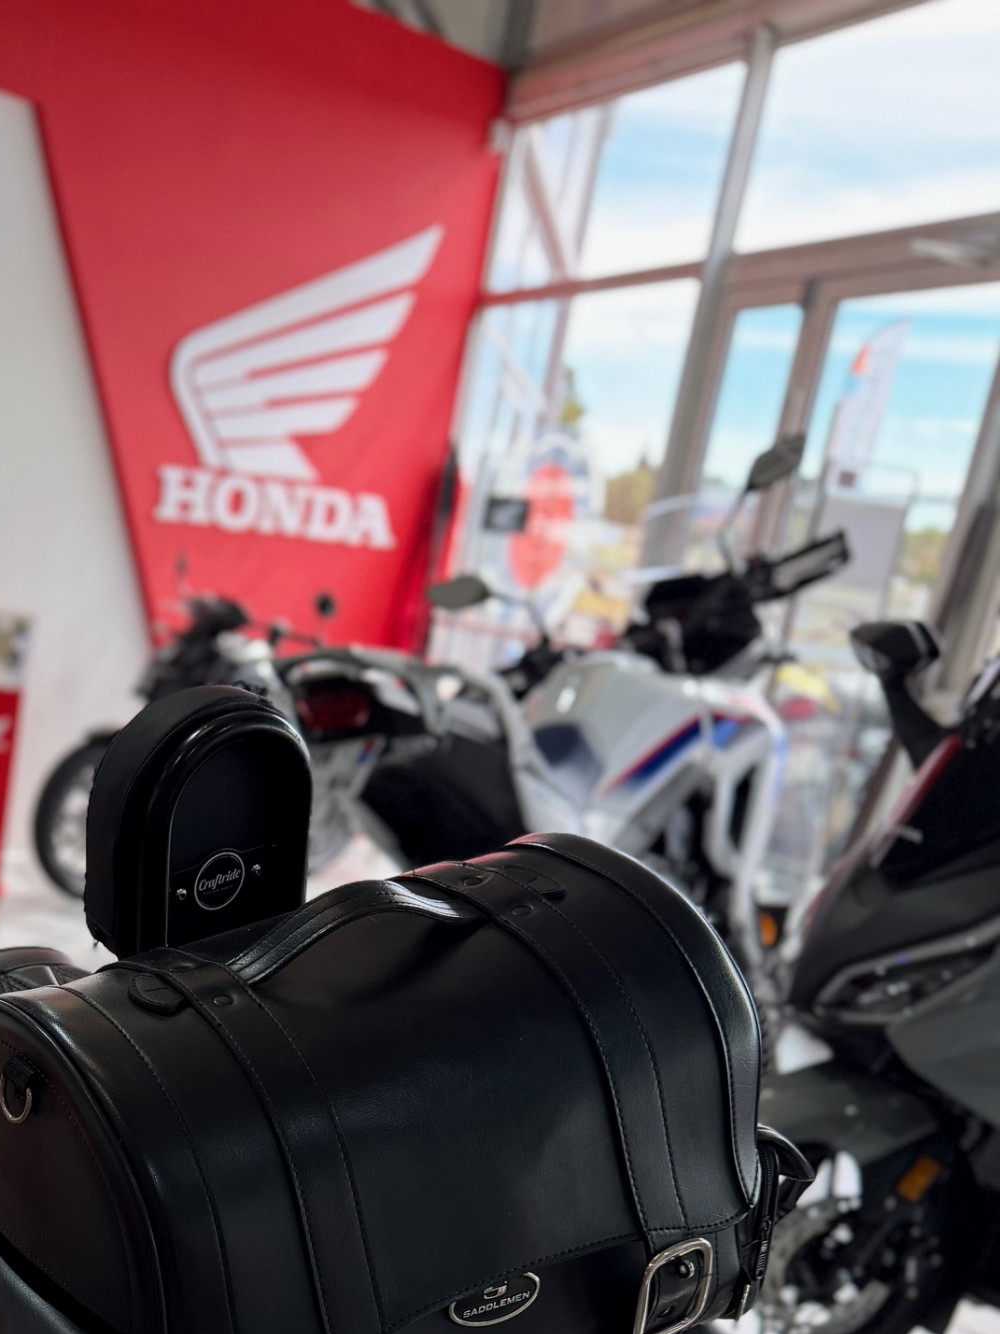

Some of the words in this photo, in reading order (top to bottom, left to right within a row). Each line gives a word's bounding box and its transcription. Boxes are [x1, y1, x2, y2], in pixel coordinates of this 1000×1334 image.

[153, 464, 396, 550] HONDA
[199, 868, 241, 891] Craftride
[463, 1290, 531, 1319] SADDLEMEN
